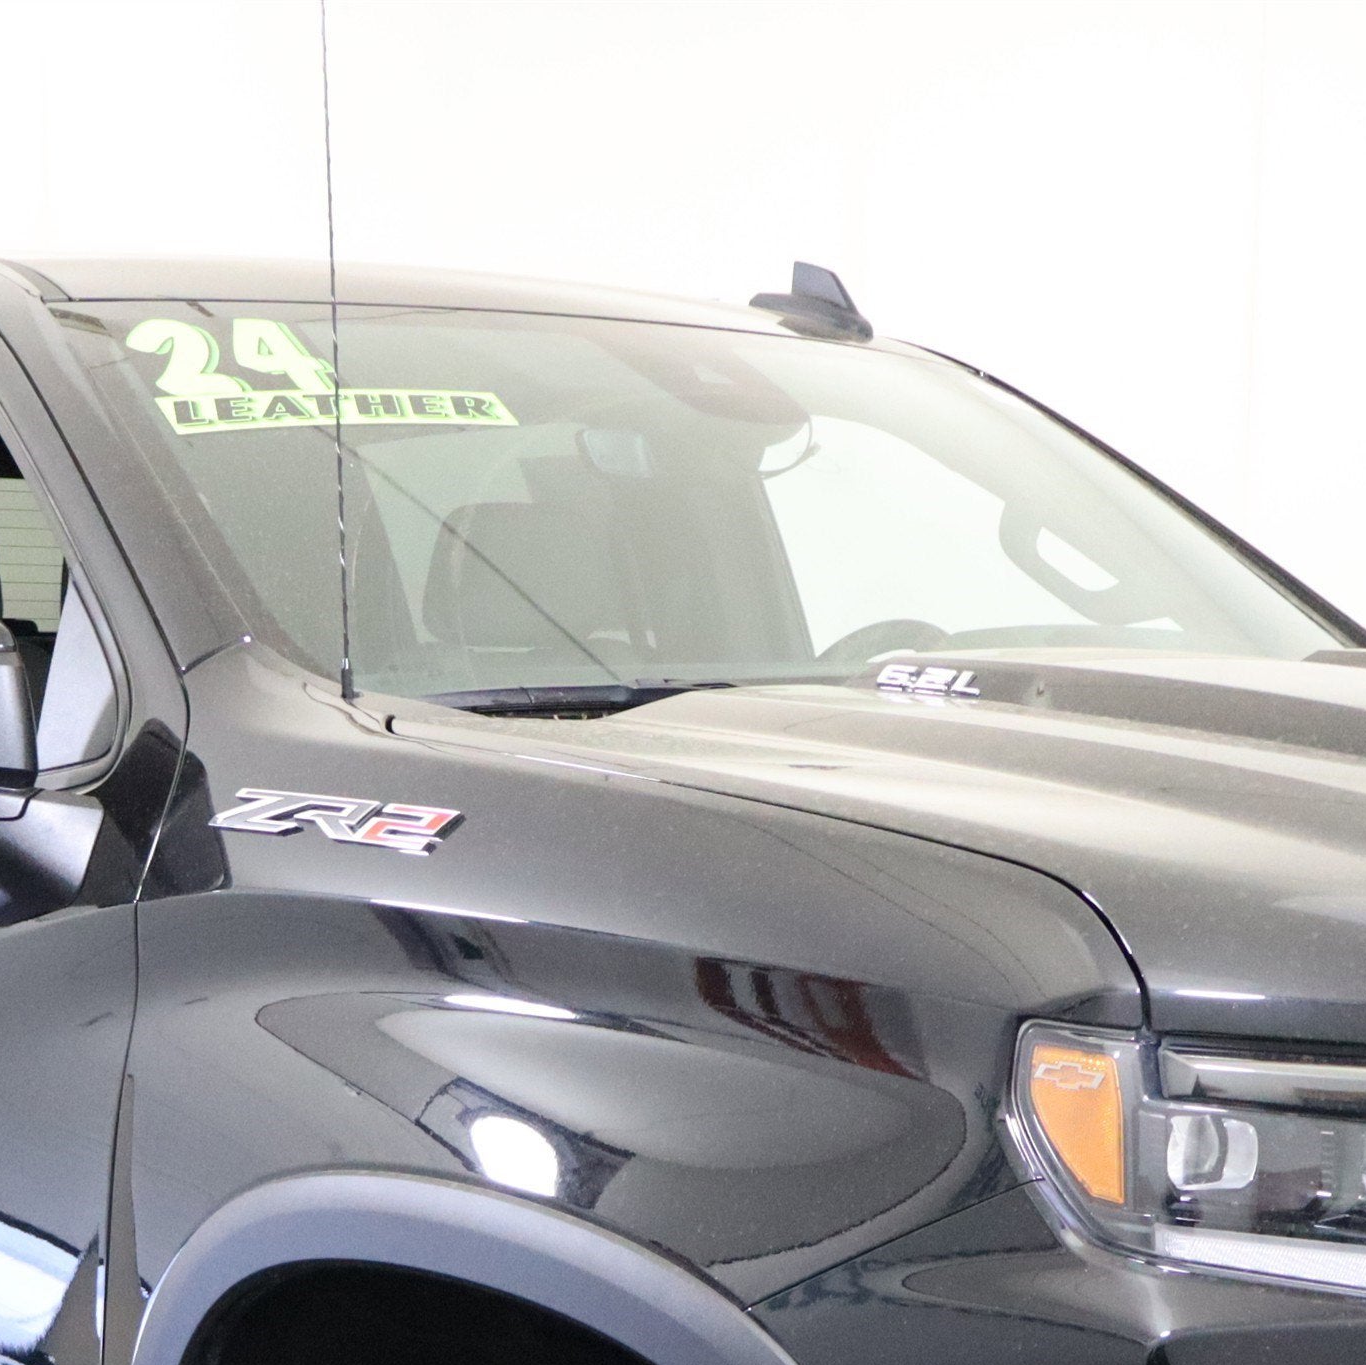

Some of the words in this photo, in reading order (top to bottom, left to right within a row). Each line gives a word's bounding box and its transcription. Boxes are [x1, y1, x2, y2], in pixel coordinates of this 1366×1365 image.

[125, 317, 337, 396] 24
[172, 392, 499, 428] LEATHER
[876, 664, 981, 697] 6.2L
[209, 788, 465, 856] ZR2
